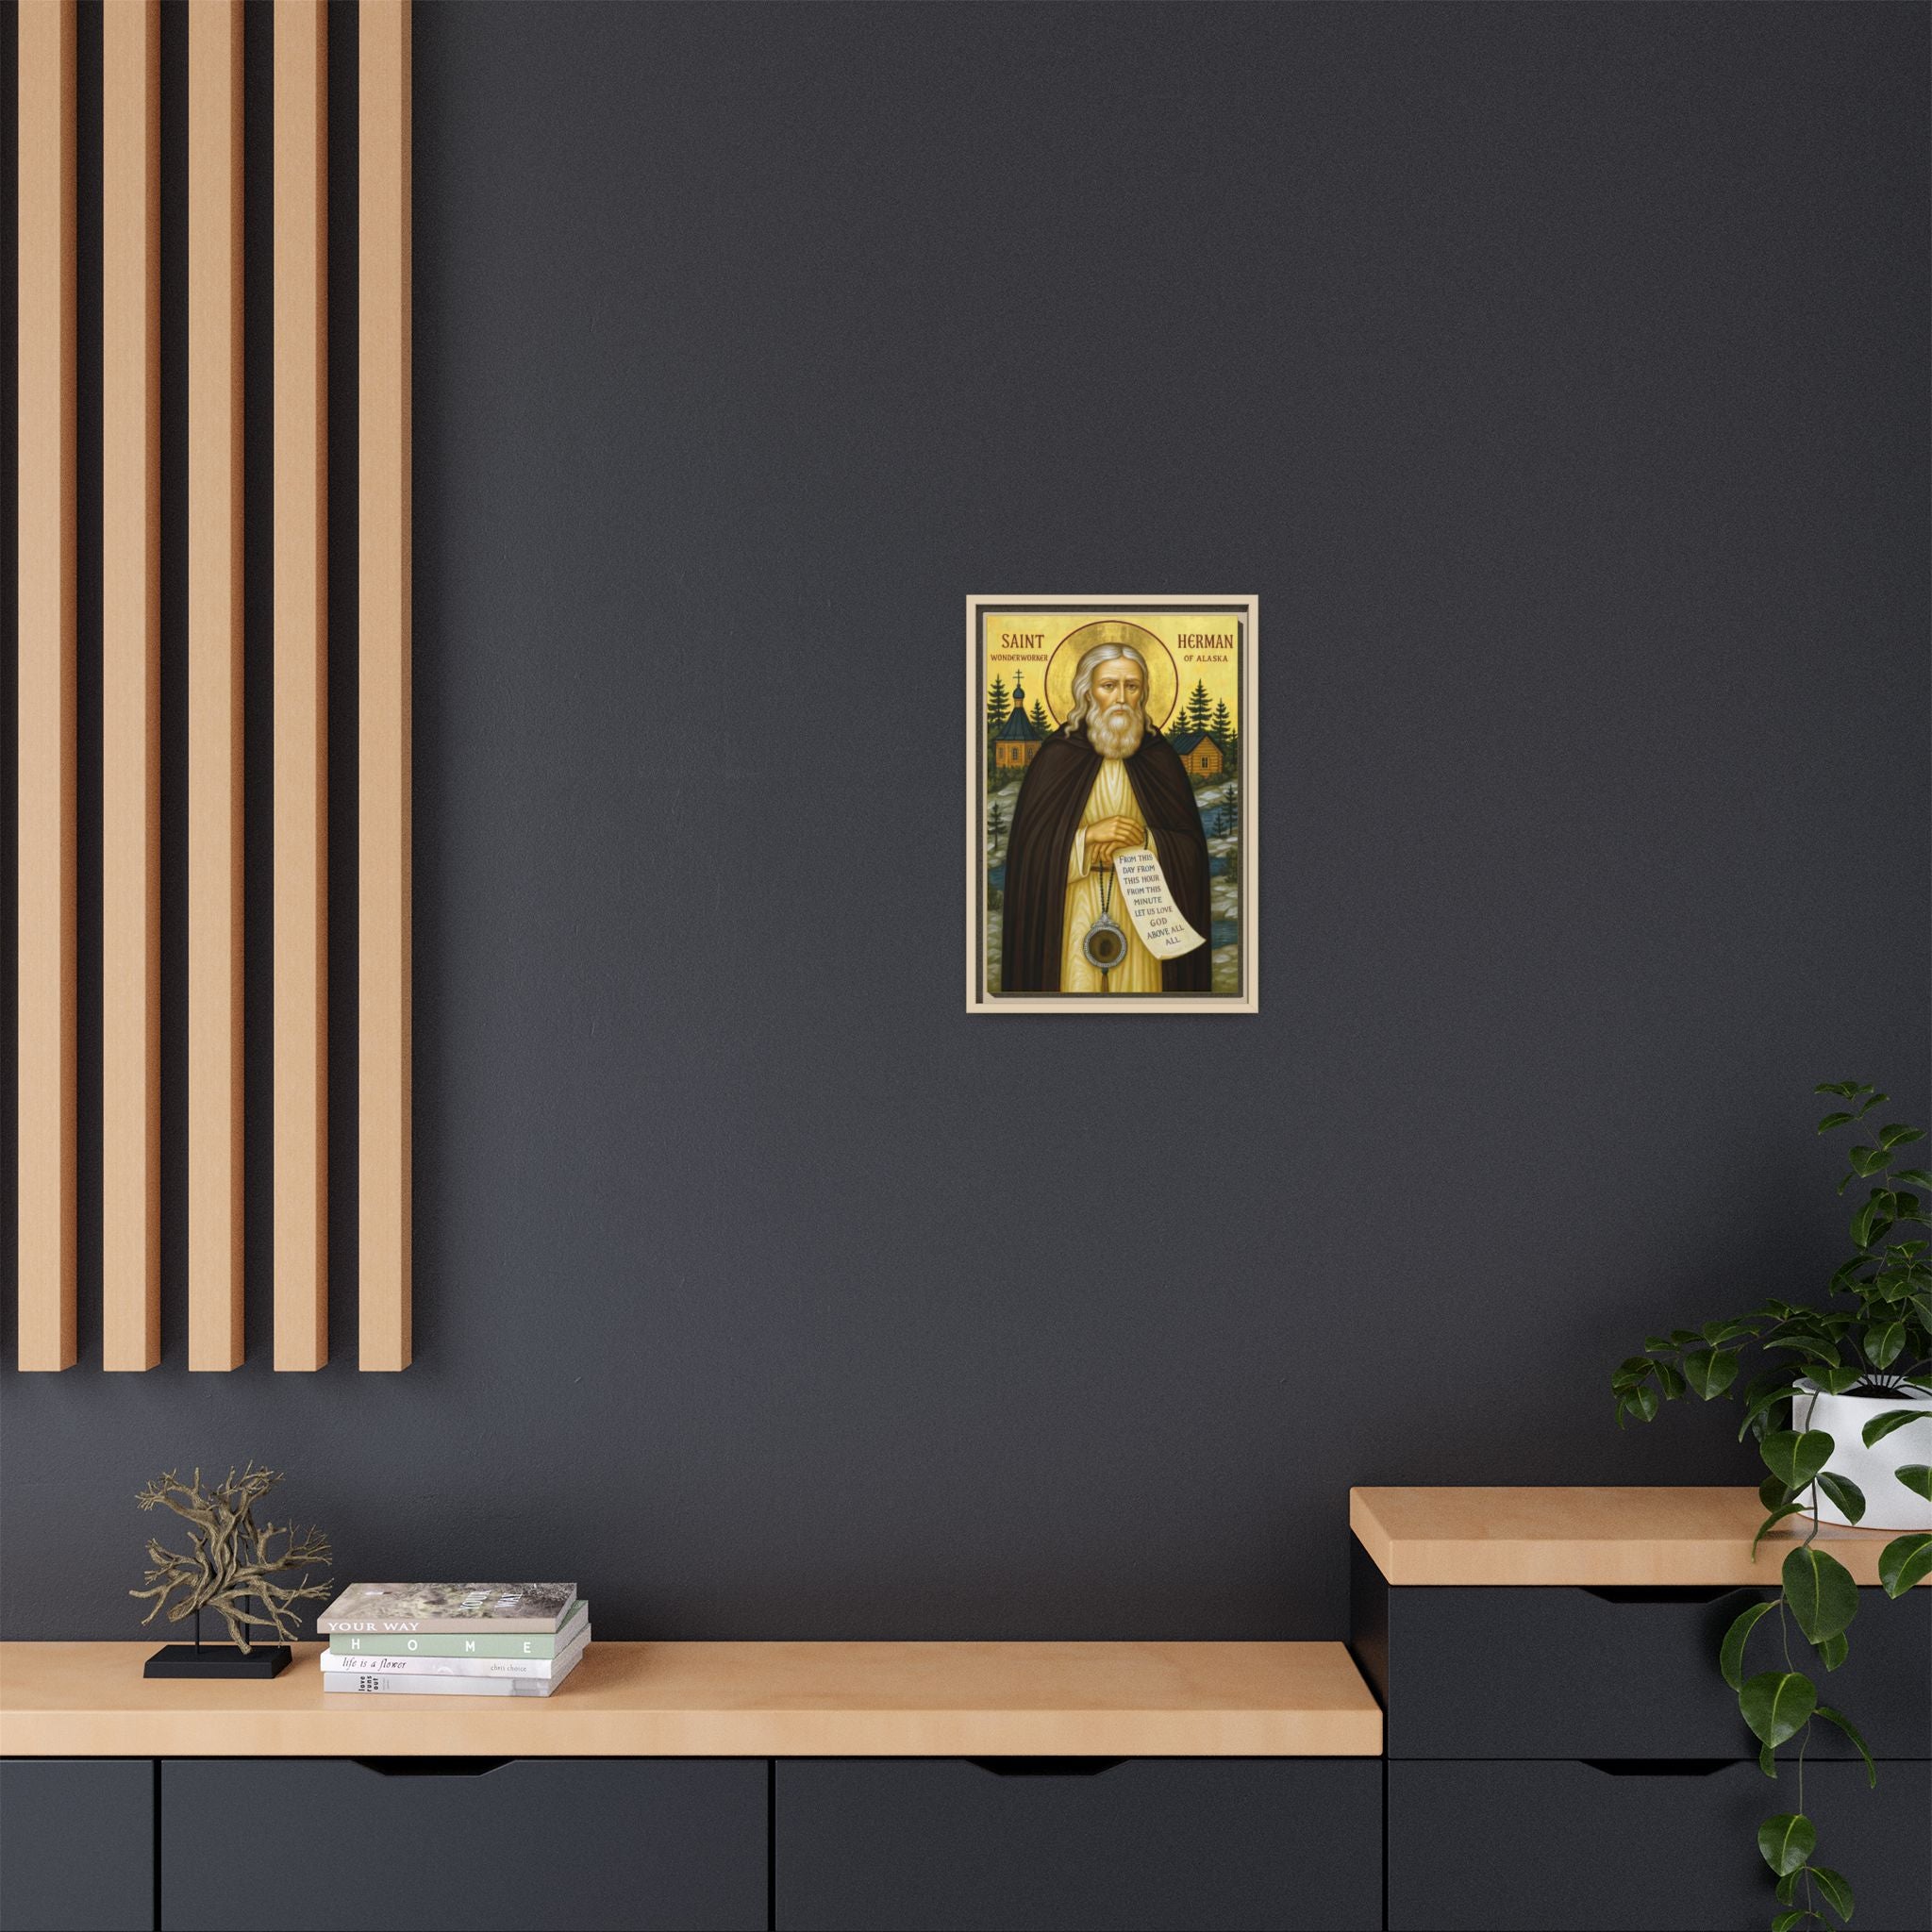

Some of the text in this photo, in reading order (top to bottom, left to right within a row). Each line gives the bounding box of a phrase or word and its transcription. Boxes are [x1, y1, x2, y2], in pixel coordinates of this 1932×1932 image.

[1002, 633, 1234, 649] SAINT HERMAN
[1119, 854, 1154, 864] FROM THIS
[1137, 865, 1156, 874] FROM
[1124, 874, 1160, 885] THIS HOUR
[1126, 886, 1161, 896] FROM THIS
[1134, 896, 1162, 906] MINUTE
[1157, 906, 1173, 914] LOVE
[1149, 918, 1168, 926] GOD
[1147, 924, 1185, 940] ABOVE ALL
[1165, 936, 1181, 945] ALL
[328, 1622, 421, 1631] YOUR WAY
[342, 1657, 358, 1671] life
[359, 1659, 367, 1668] is
[377, 1658, 407, 1672] flower
